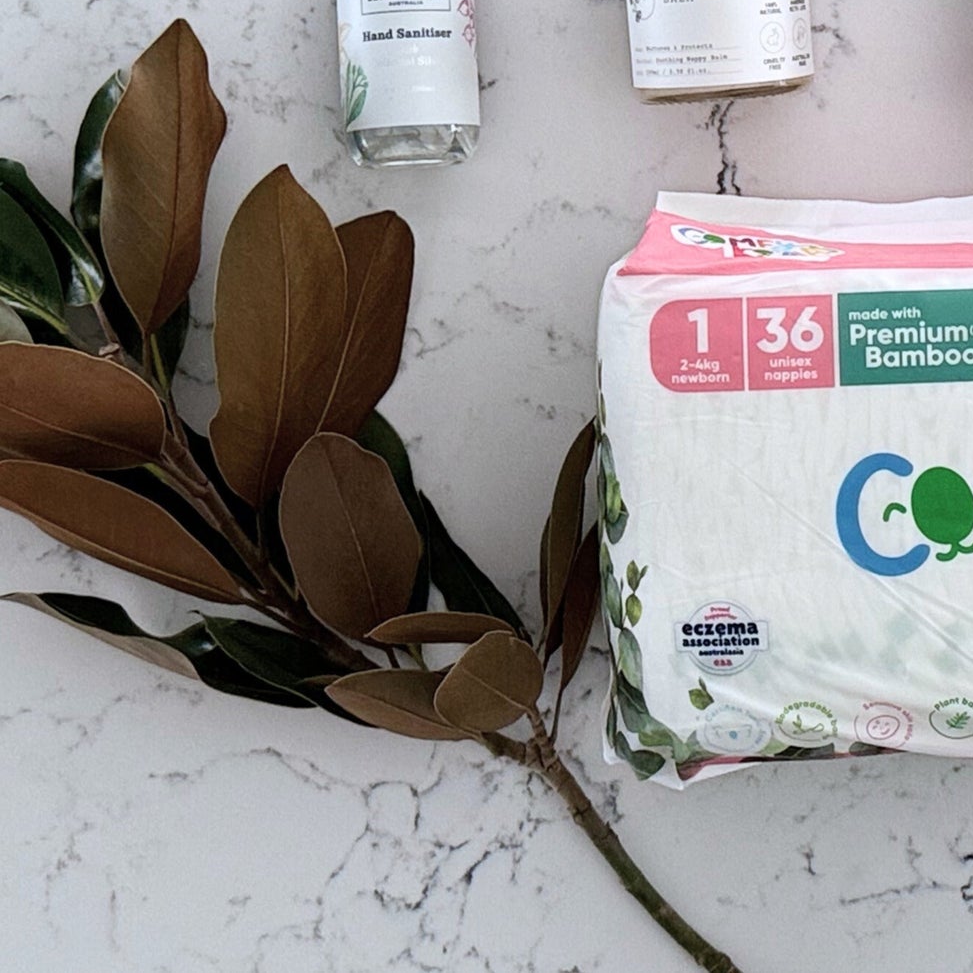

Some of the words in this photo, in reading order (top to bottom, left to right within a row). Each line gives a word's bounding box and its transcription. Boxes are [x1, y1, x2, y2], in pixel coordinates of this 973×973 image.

[362, 28, 394, 42] Hand
[396, 26, 453, 40] Sanitiser
[848, 307, 889, 321] made
[891, 306, 922, 319] with
[687, 308, 709, 354] 1
[755, 305, 825, 354] 36
[850, 320, 969, 346] Premium
[680, 358, 721, 373] 2-4kg
[769, 355, 813, 368] unisex
[671, 371, 731, 384] newborn
[764, 368, 819, 384] nappies
[682, 622, 759, 636] eczema
[682, 636, 760, 648] association
[698, 647, 745, 657] australasia
[934, 696, 960, 712] Plant
